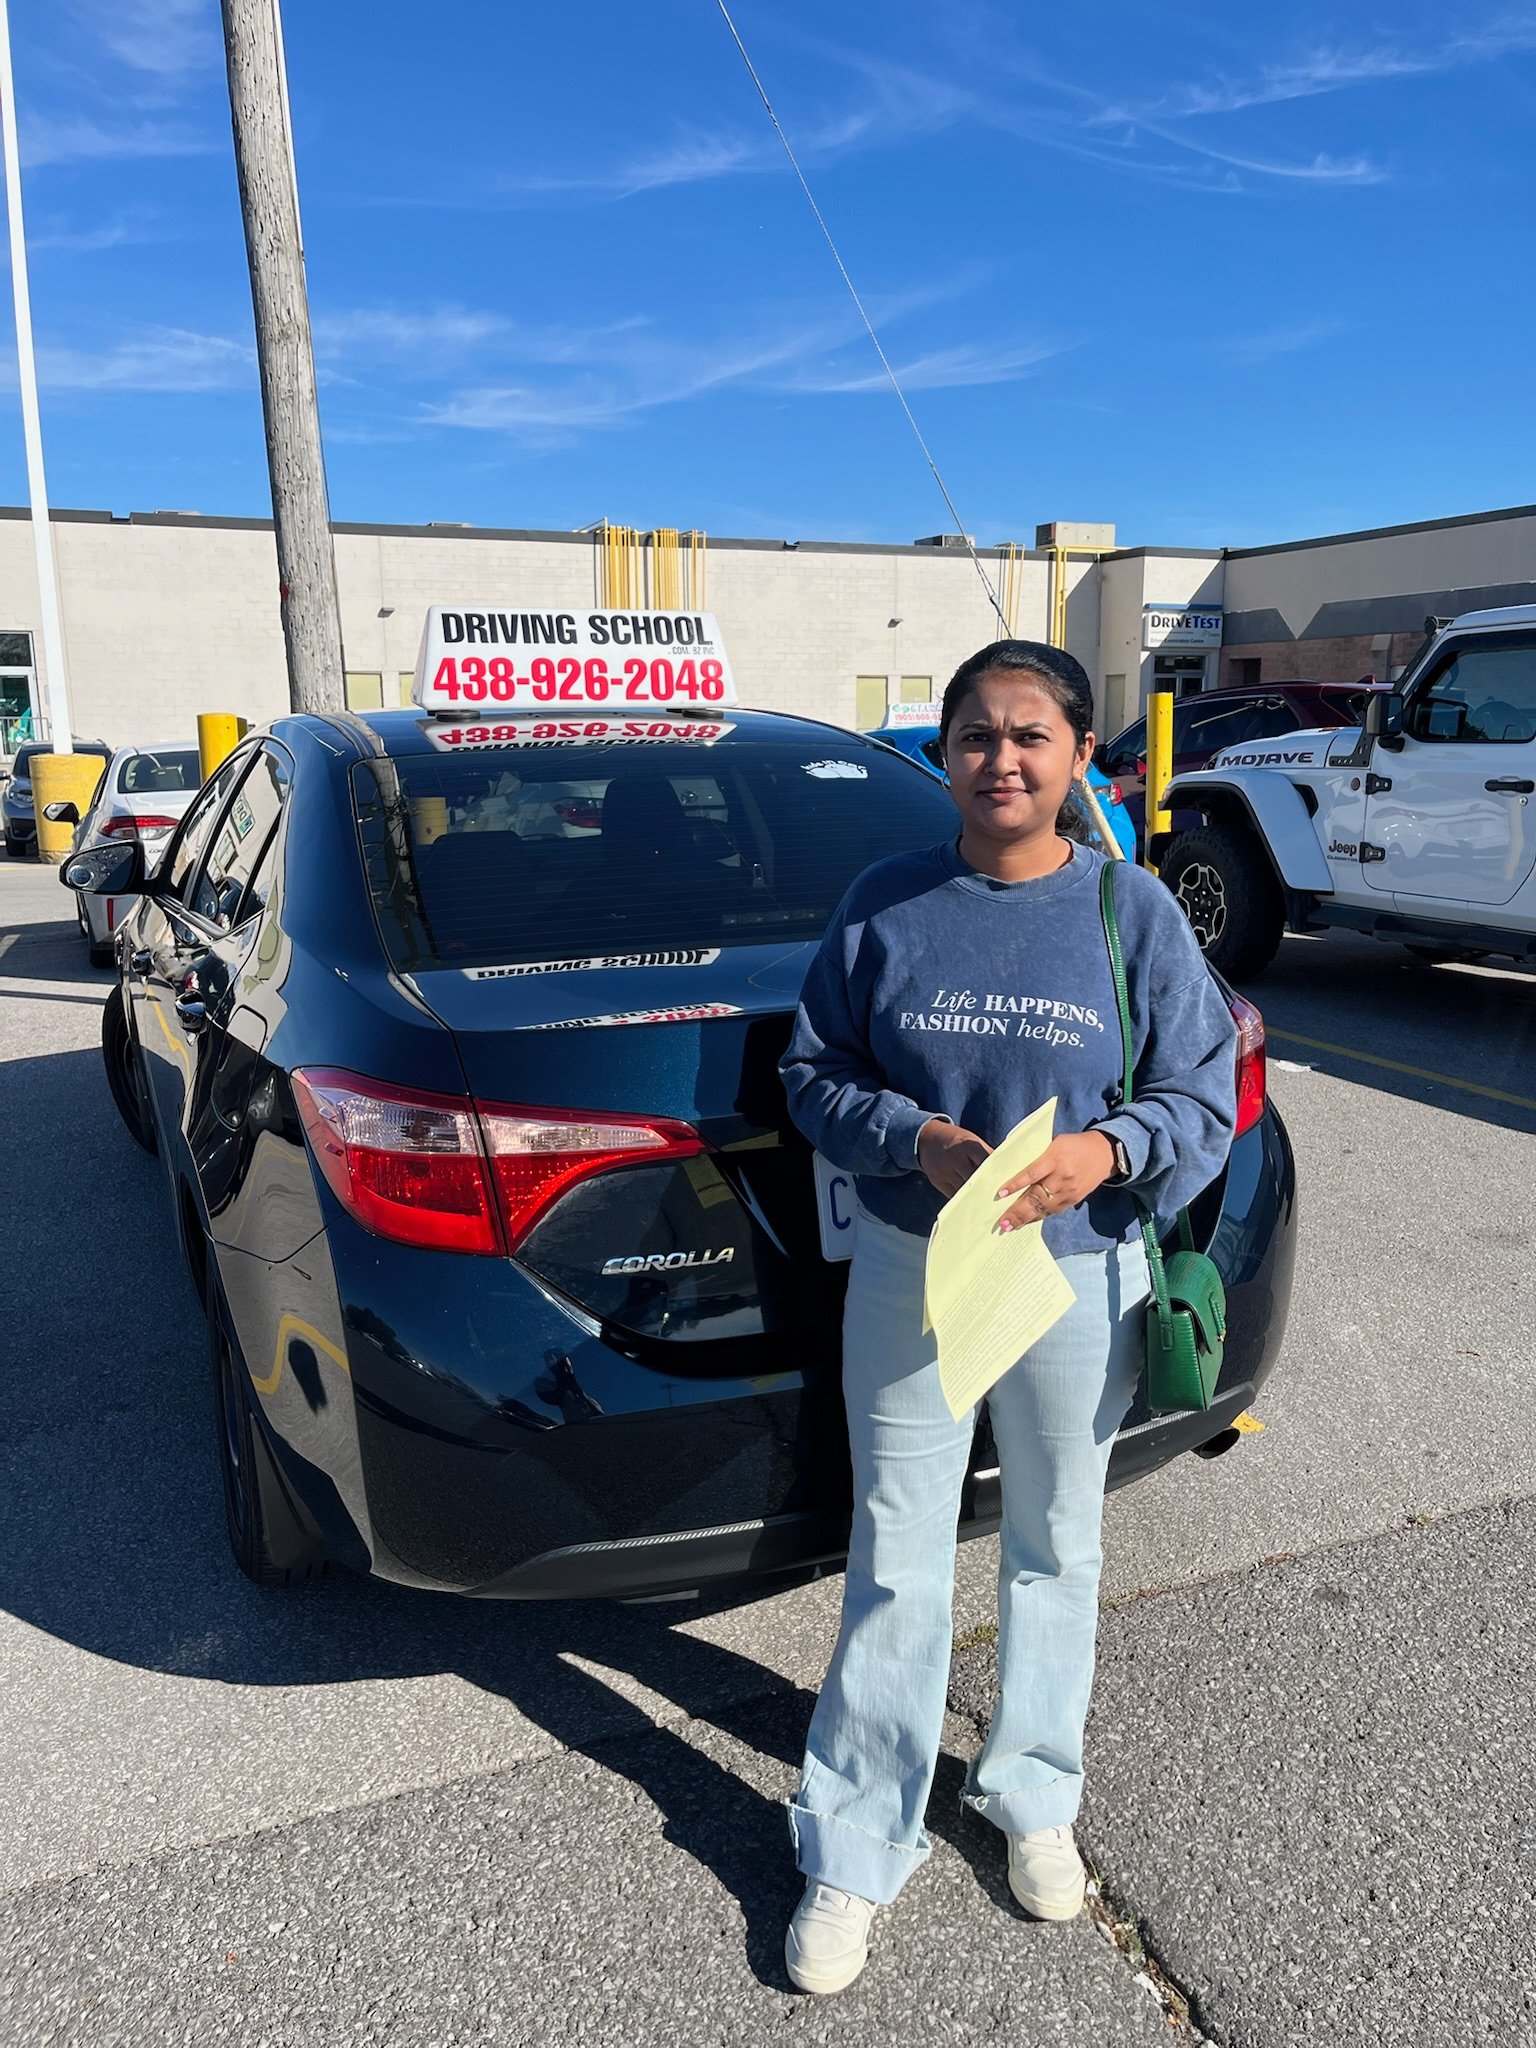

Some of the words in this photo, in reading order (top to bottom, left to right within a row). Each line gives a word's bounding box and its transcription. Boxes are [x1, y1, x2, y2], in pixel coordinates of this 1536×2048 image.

[441, 613, 578, 645] DRIVING
[590, 614, 713, 646] SCHOOL
[433, 657, 725, 701] 438-926-2048
[1221, 752, 1314, 767] MOJAVE
[1329, 839, 1357, 856] Jeep
[931, 989, 977, 1012] Life
[984, 994, 1105, 1033] HAPPENS,
[899, 1012, 1010, 1036] FASHION
[1017, 1017, 1085, 1047] helps.
[601, 1247, 735, 1276] COROLLA
